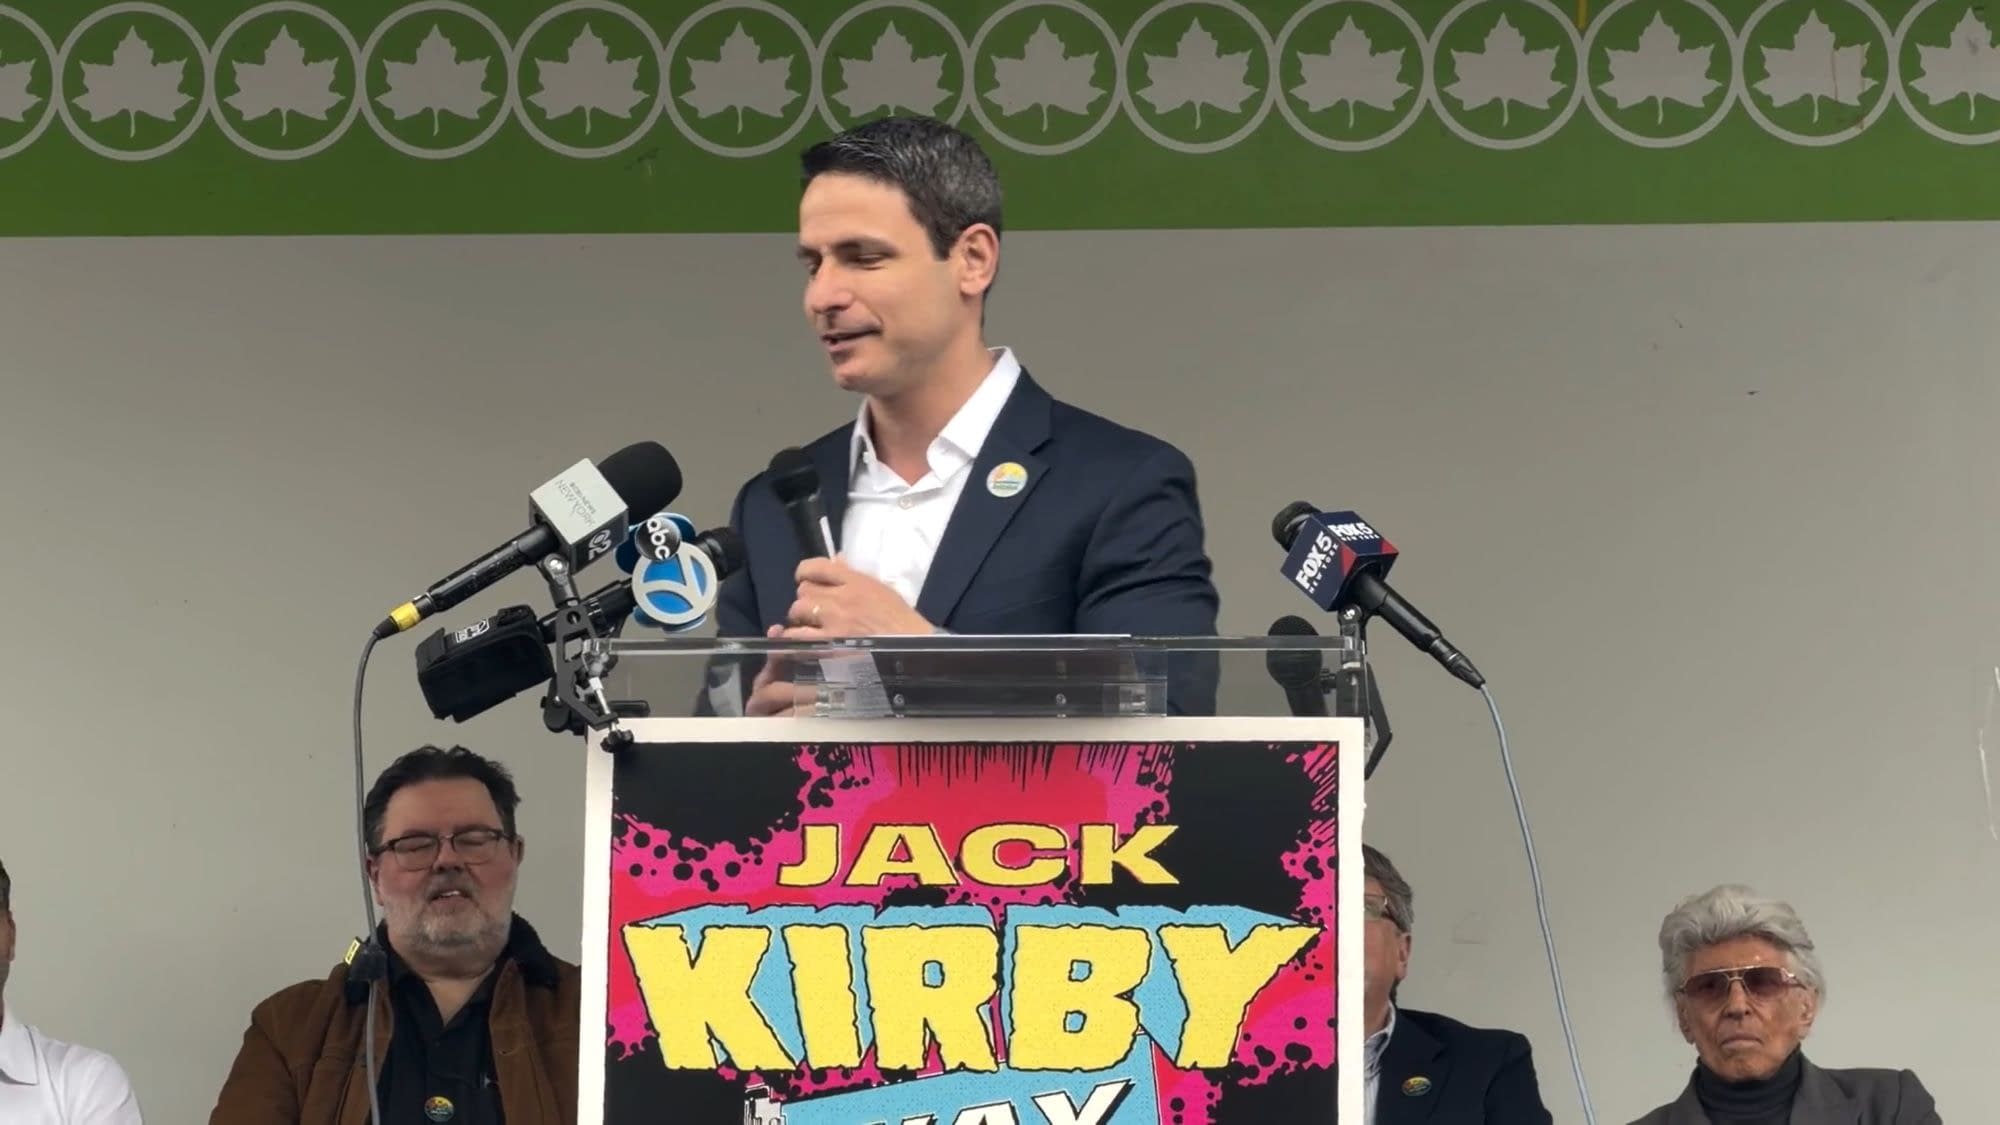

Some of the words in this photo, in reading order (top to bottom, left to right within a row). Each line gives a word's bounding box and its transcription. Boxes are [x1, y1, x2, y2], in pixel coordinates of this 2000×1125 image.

[646, 516, 671, 561] abc
[1295, 543, 1327, 590] FOX
[1315, 530, 1333, 552] 5
[1327, 523, 1363, 538] FOX
[1355, 522, 1374, 535] 5
[777, 822, 1181, 887] JACK
[621, 921, 1324, 1073] KIRBY
